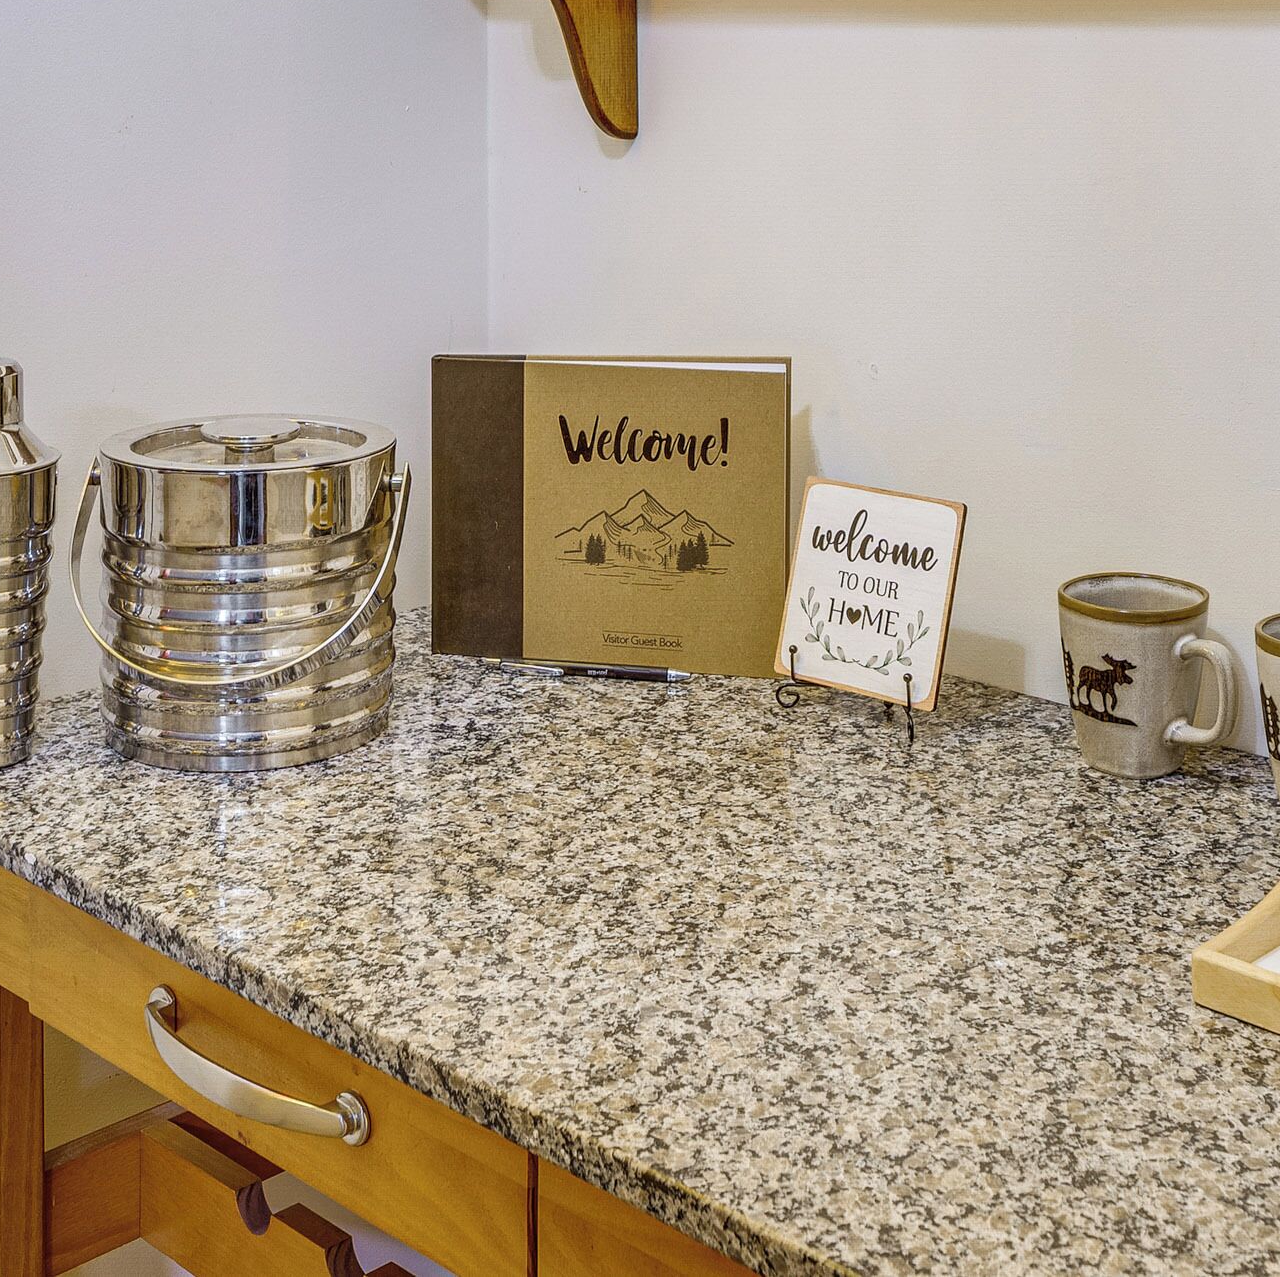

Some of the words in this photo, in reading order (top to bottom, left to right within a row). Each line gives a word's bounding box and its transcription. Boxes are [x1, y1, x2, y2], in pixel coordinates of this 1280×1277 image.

[558, 414, 729, 472] Welcome!
[812, 509, 938, 572] welcome
[838, 570, 858, 591] TO
[863, 576, 899, 600] OUR
[603, 633, 629, 645] Visitor
[631, 636, 657, 646] Guest
[659, 638, 682, 648] Book
